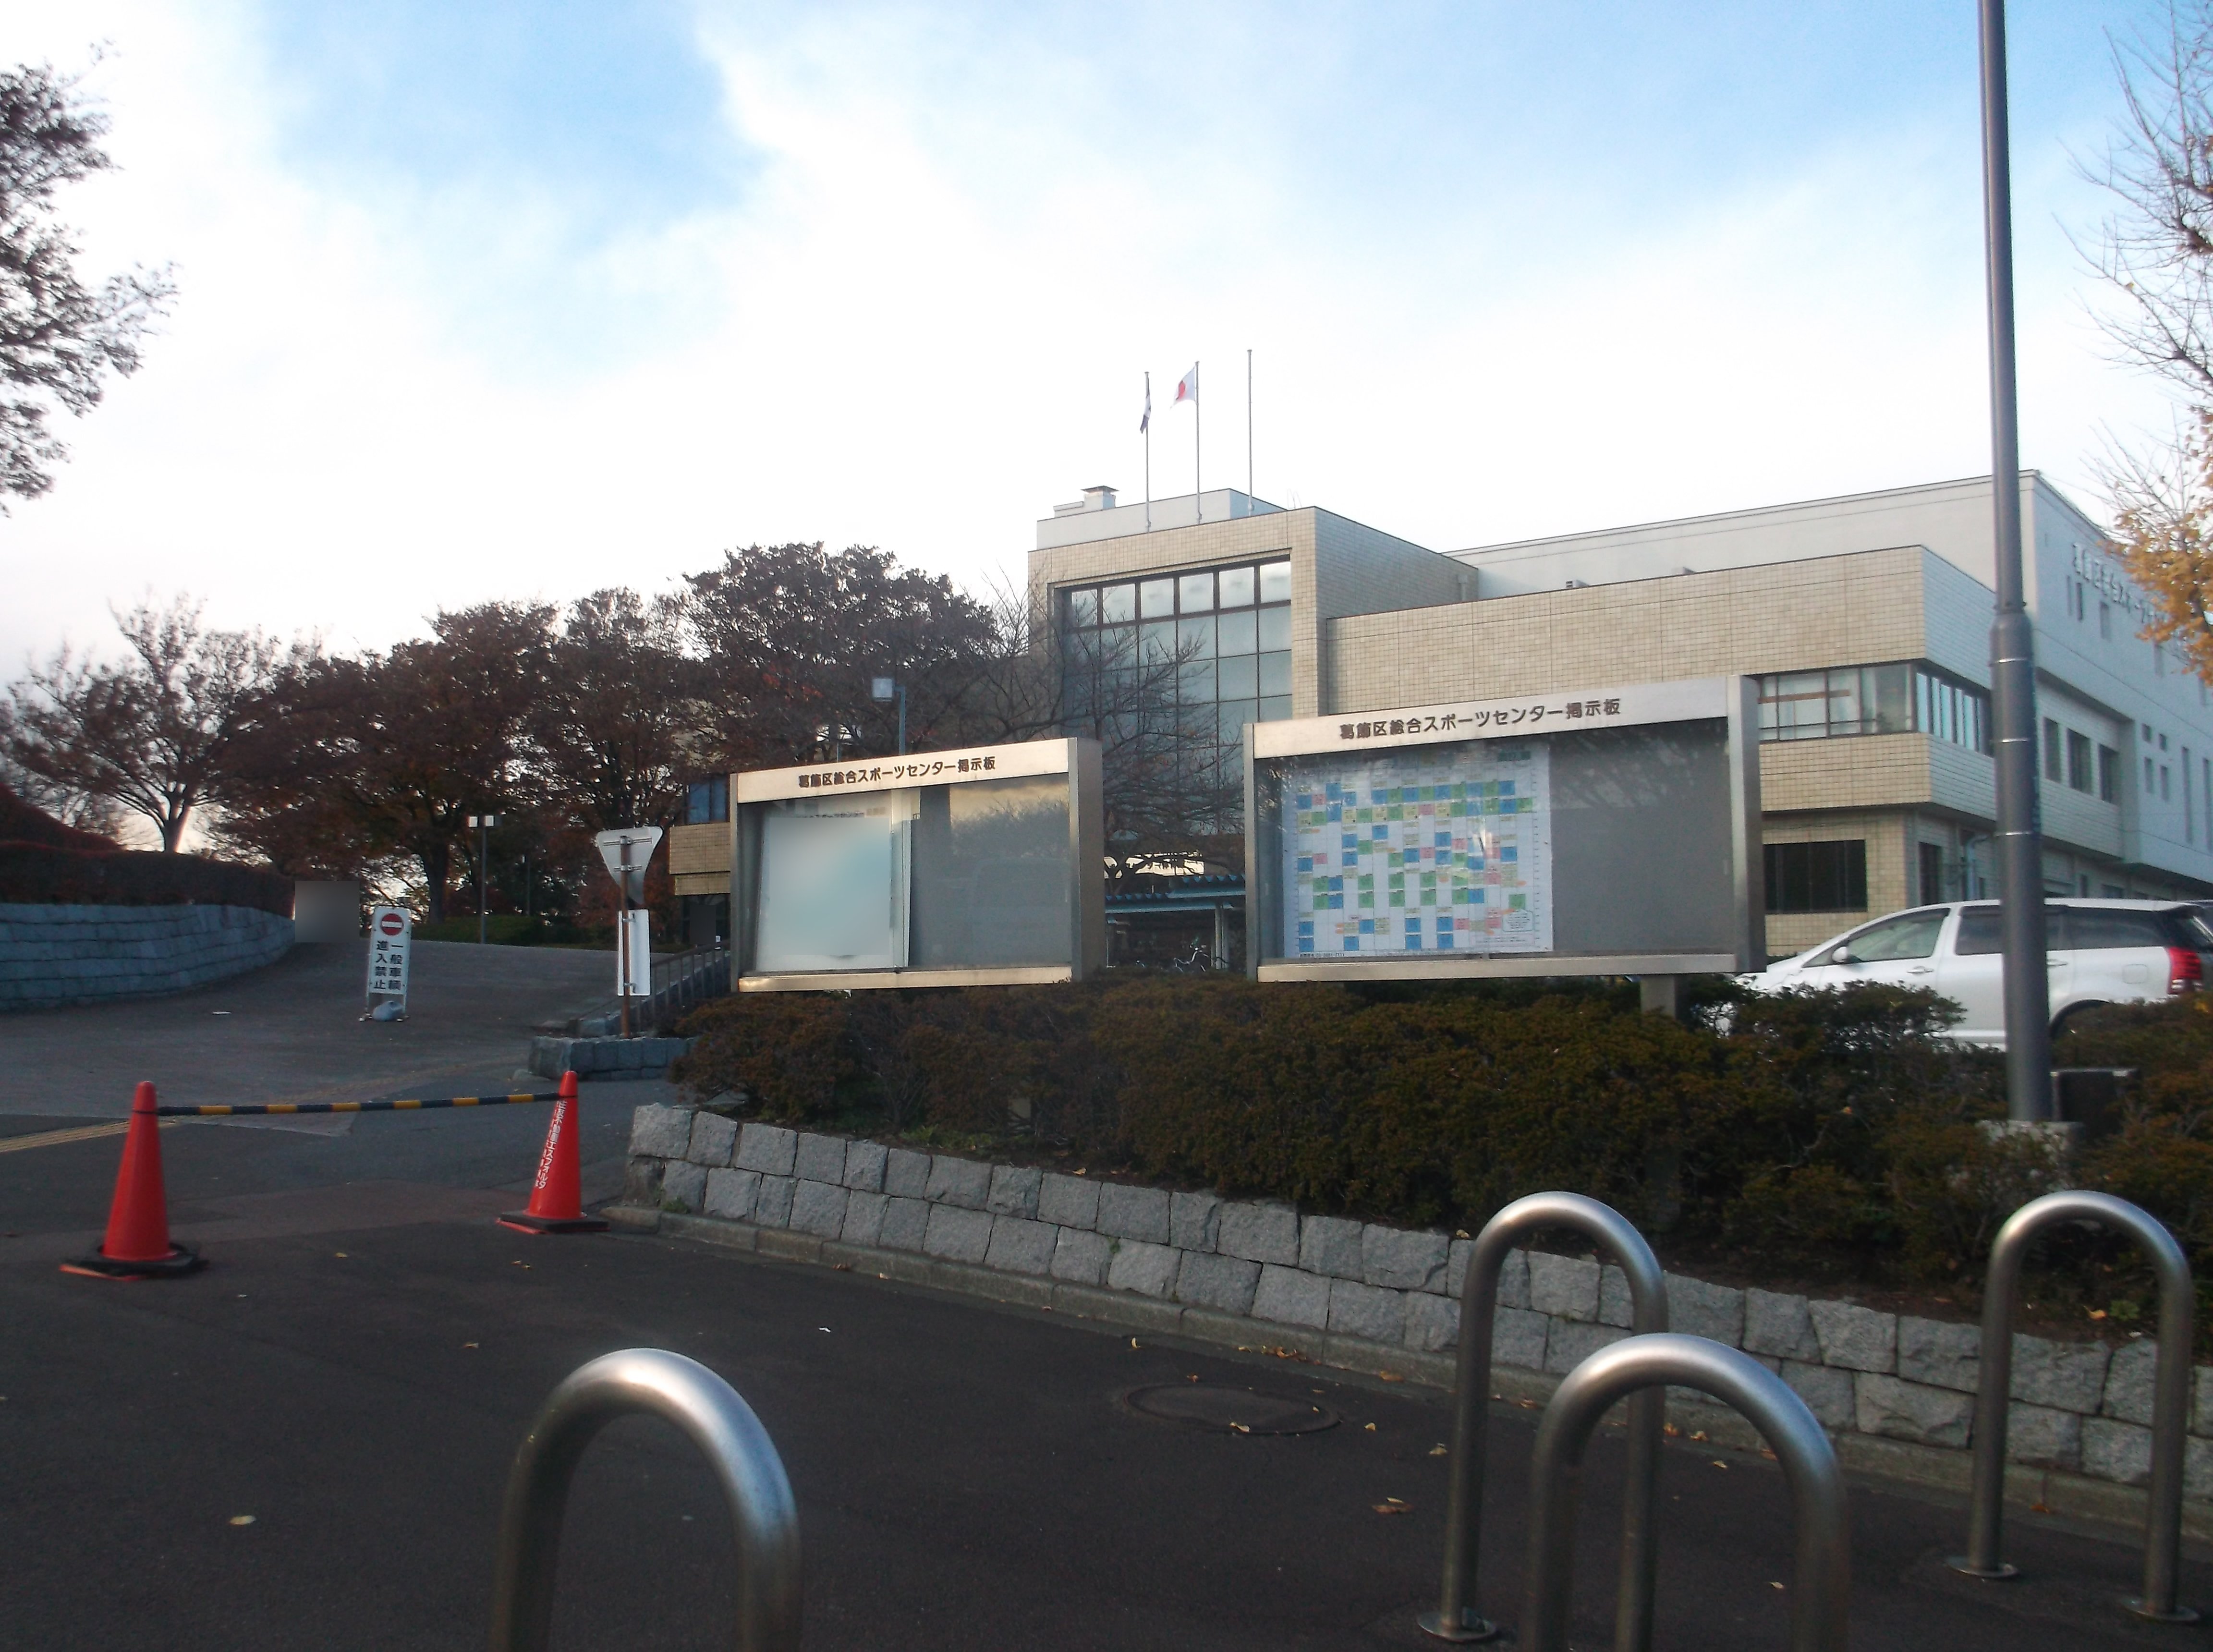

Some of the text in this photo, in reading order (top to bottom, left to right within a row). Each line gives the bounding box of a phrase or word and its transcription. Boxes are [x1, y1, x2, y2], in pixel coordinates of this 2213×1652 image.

[1340, 698, 1621, 739] 葛飾区総合スポーツセンター掲示板
[374, 940, 388, 989] 進入禁止
